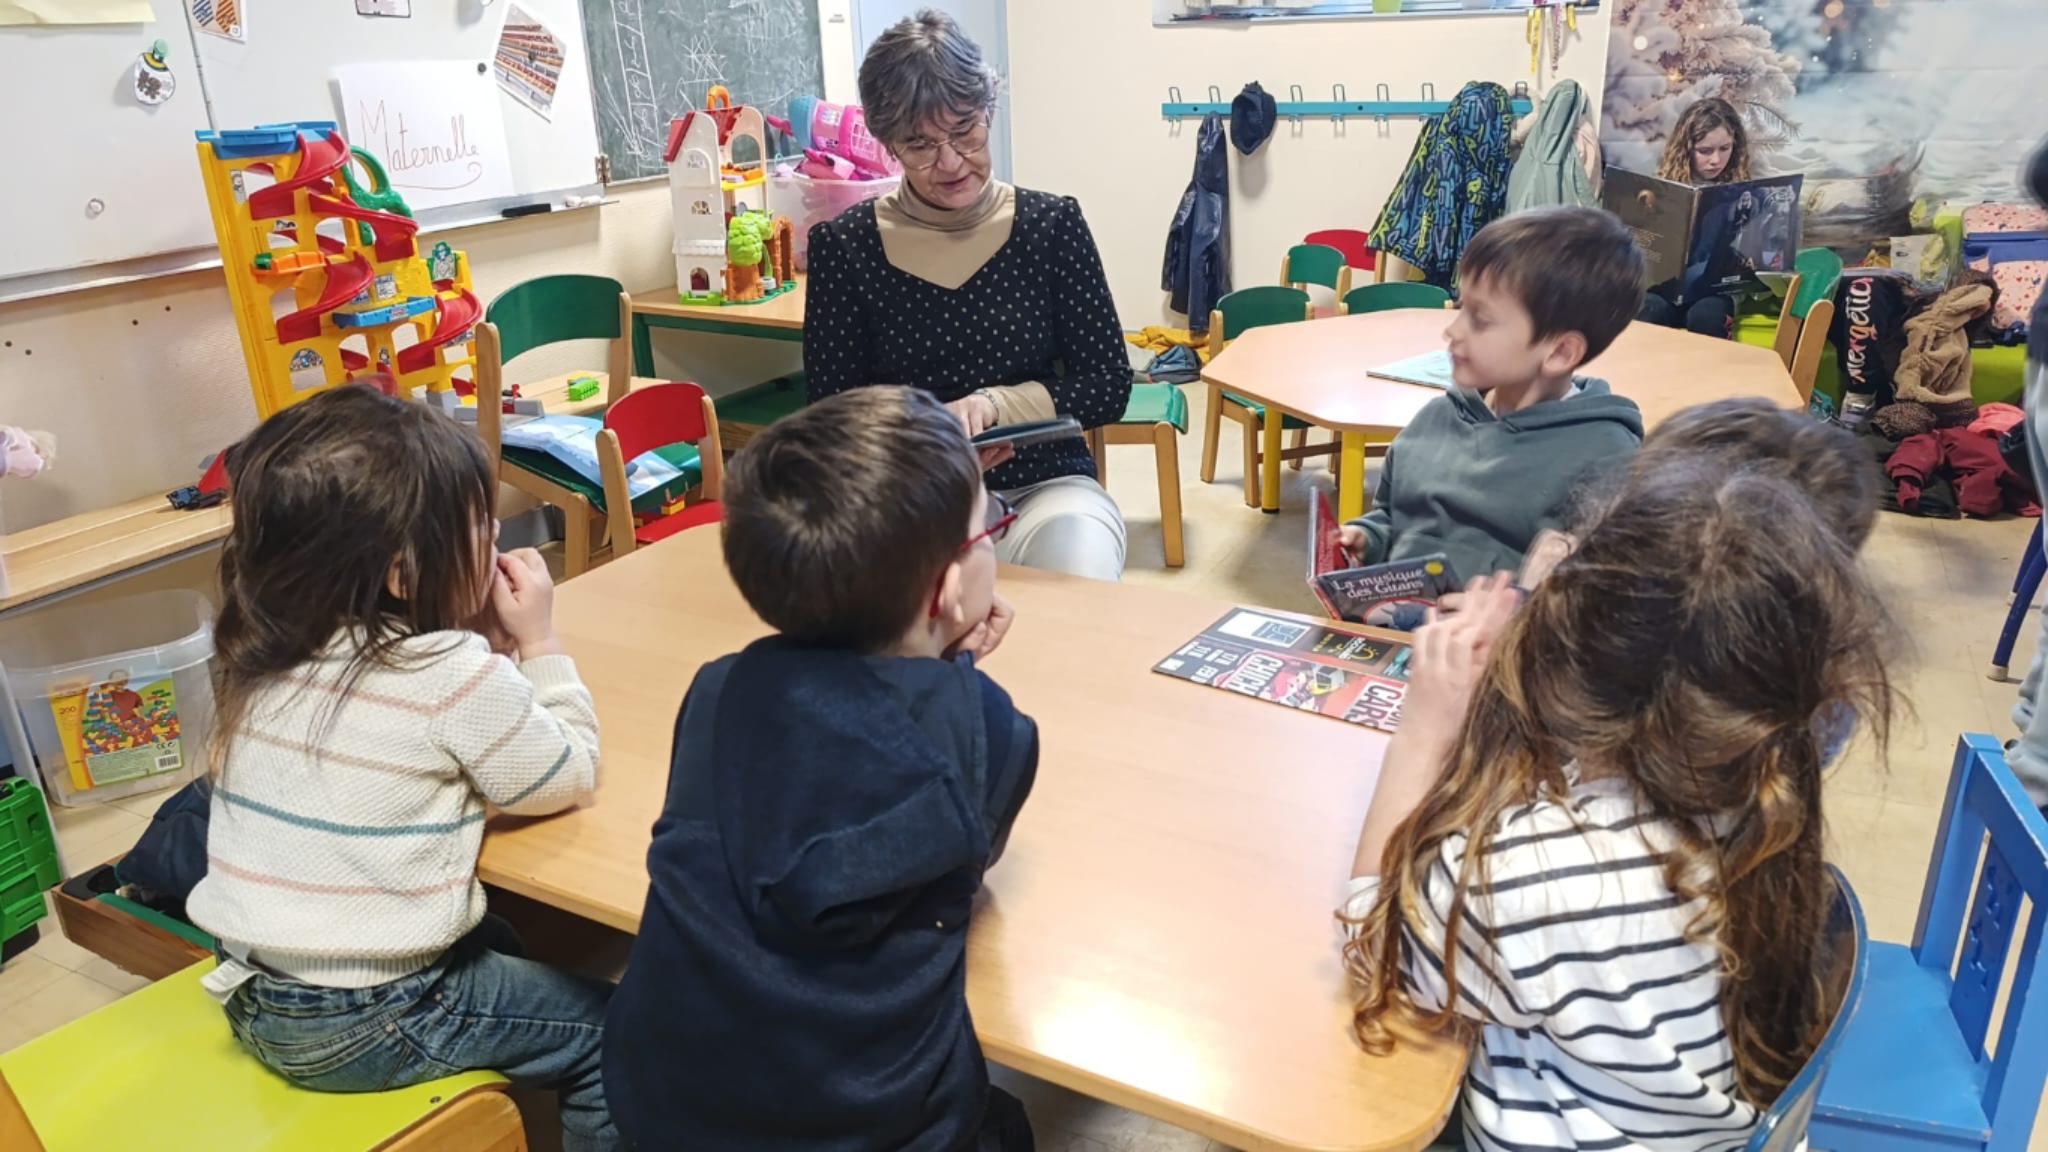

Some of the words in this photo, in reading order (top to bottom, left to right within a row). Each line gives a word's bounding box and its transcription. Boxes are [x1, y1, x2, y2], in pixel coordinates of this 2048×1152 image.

[360, 99, 480, 173] Maternelle
[1331, 579, 1354, 592] La
[1360, 568, 1425, 588] musique
[1346, 586, 1373, 599] des
